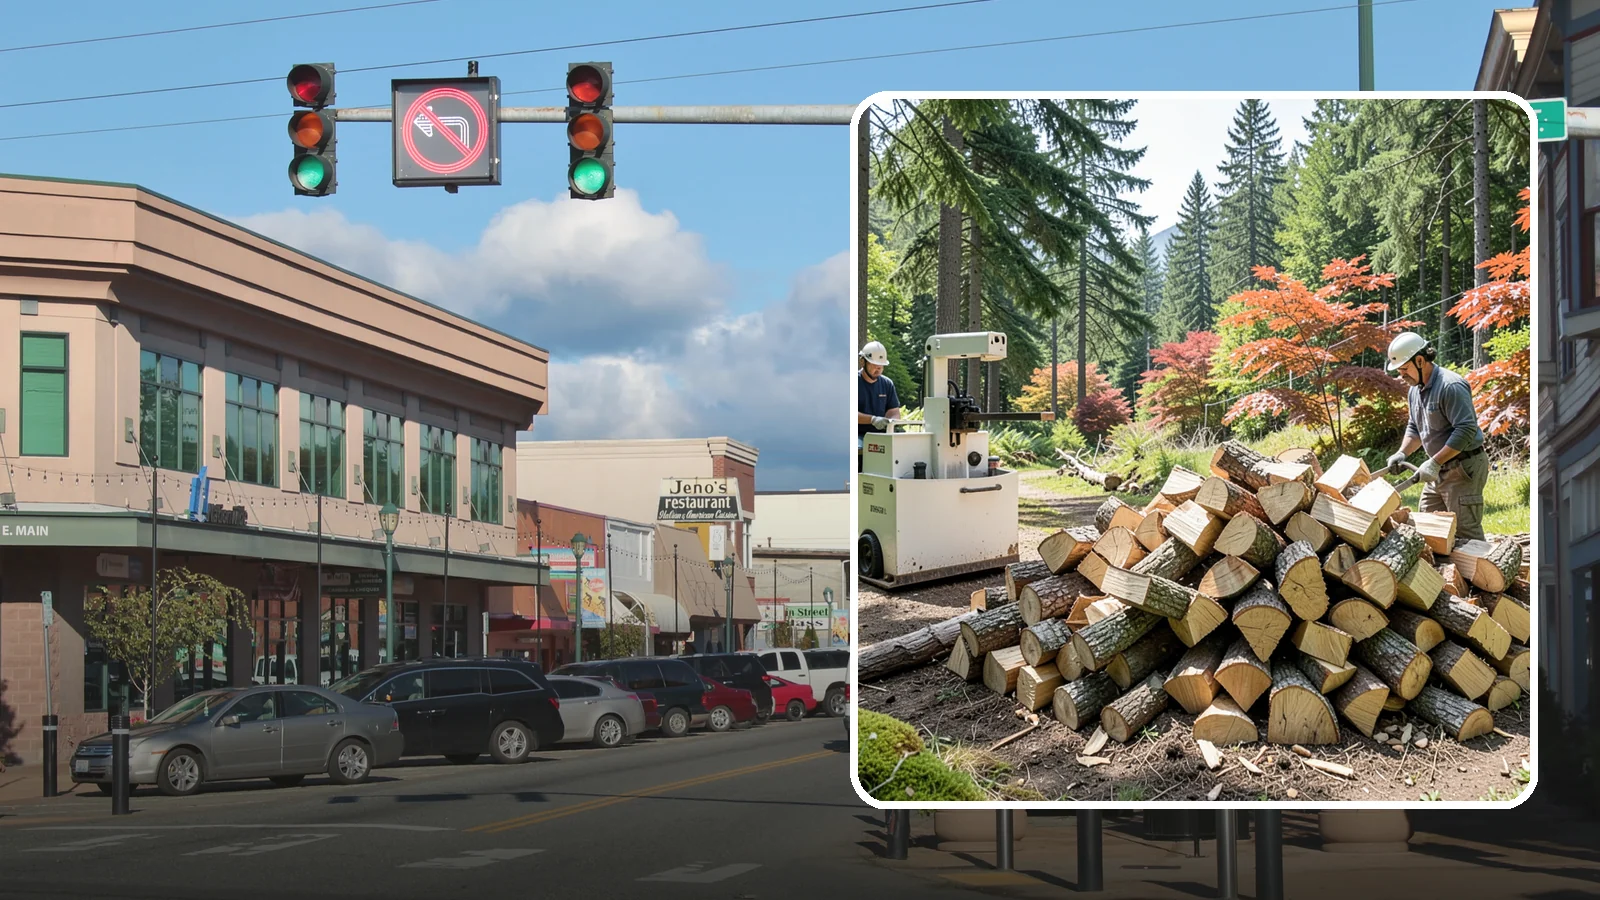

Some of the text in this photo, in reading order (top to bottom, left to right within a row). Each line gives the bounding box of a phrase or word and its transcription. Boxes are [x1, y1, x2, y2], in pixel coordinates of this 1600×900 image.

[670, 480, 727, 494] Jeno's
[665, 496, 731, 509] restaurant
[659, 509, 682, 520] Italian
[686, 509, 714, 520] American
[715, 509, 738, 520] Cuisine
[2, 525, 49, 536] E. MAIN
[797, 607, 828, 617] Street
